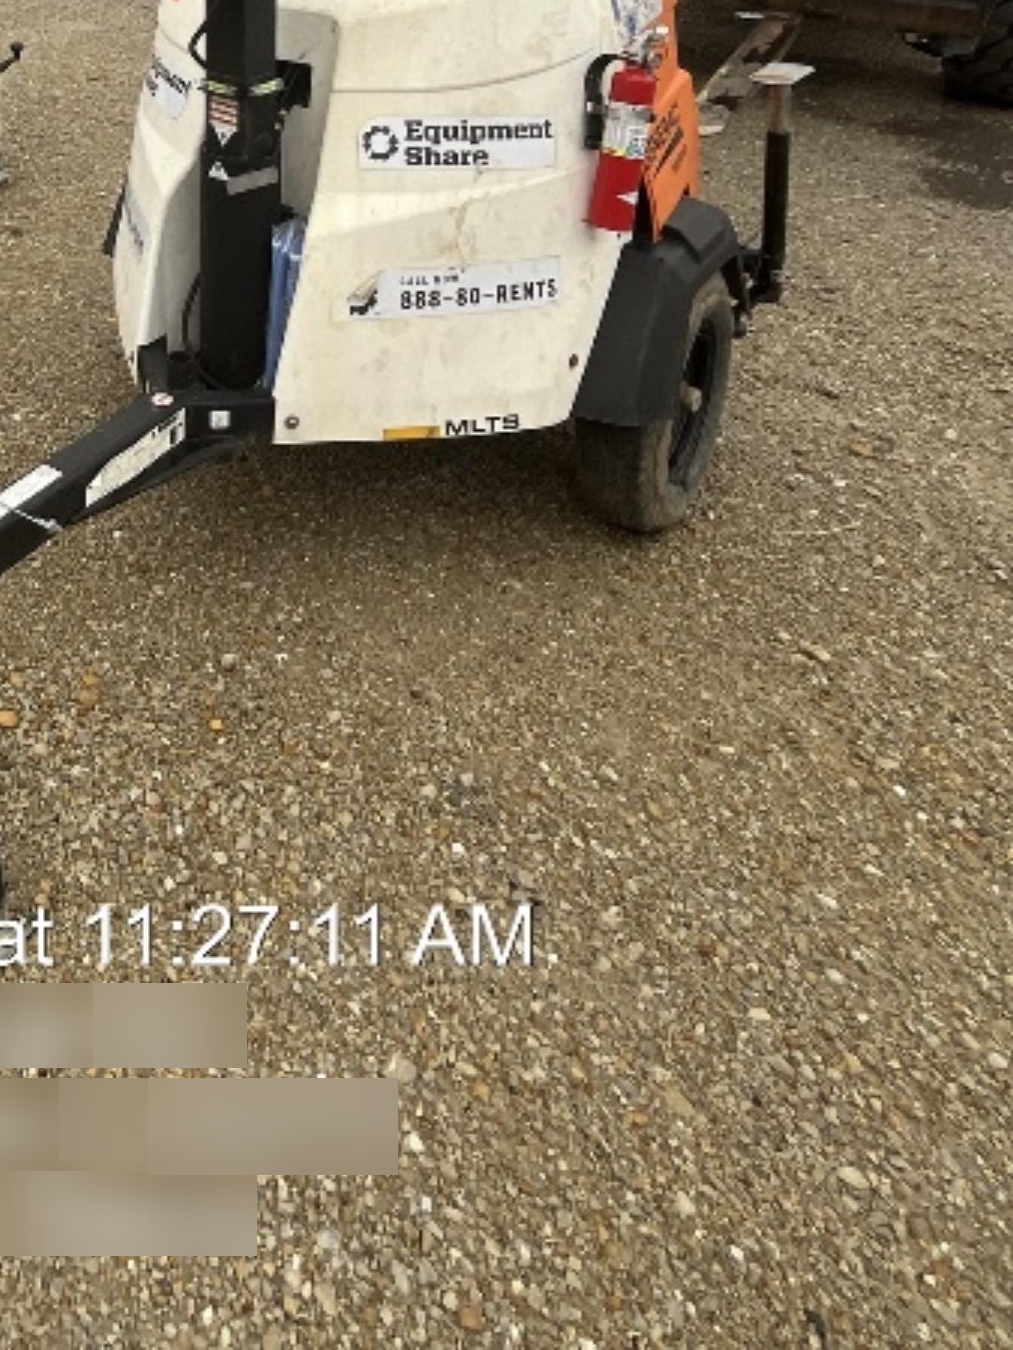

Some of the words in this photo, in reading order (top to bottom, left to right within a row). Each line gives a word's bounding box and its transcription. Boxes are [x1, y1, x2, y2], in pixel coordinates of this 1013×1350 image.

[404, 119, 553, 145] Equipment
[404, 146, 489, 166] Share
[400, 278, 558, 310] 888-80-RENTS
